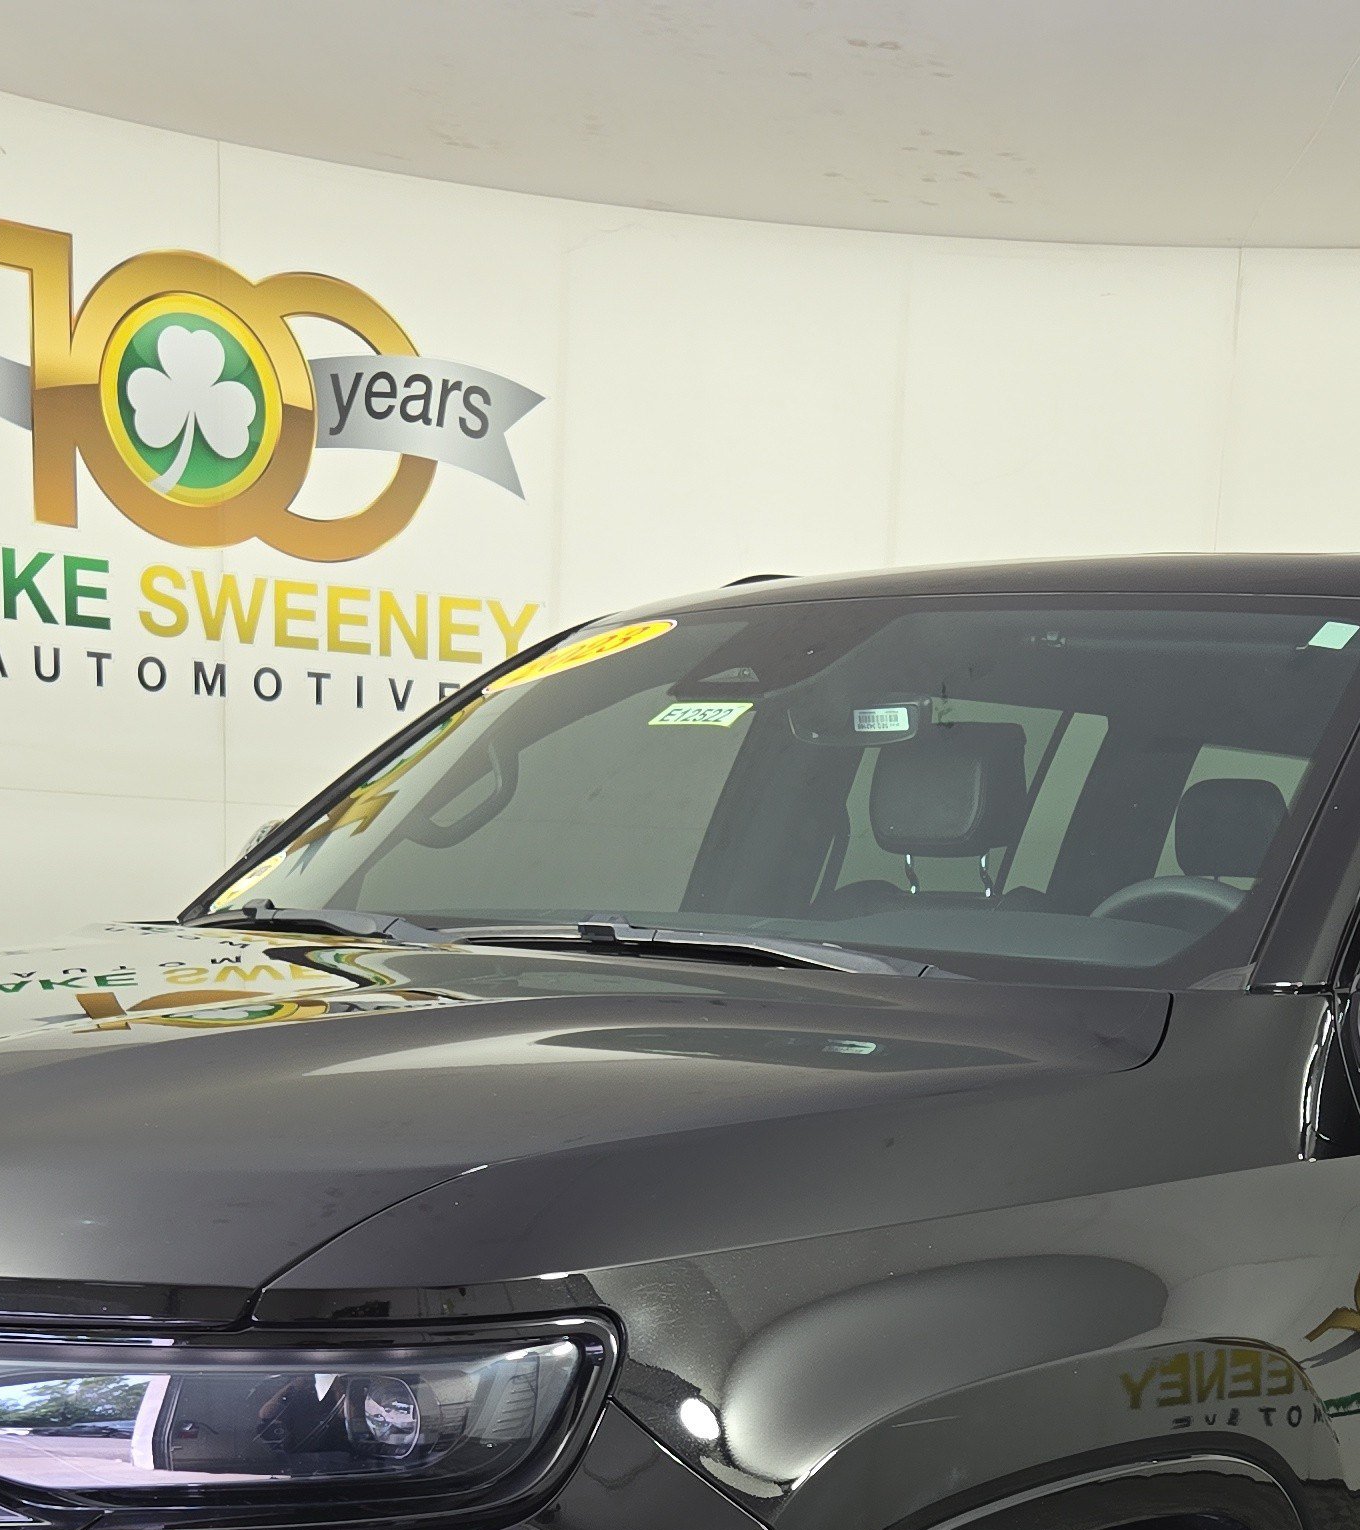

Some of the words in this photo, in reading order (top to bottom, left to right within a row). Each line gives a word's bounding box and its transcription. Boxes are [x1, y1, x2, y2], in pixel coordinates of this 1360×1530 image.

[329, 369, 492, 440] years
[138, 565, 540, 666] SWEENEY
[658, 708, 734, 723] E12522
